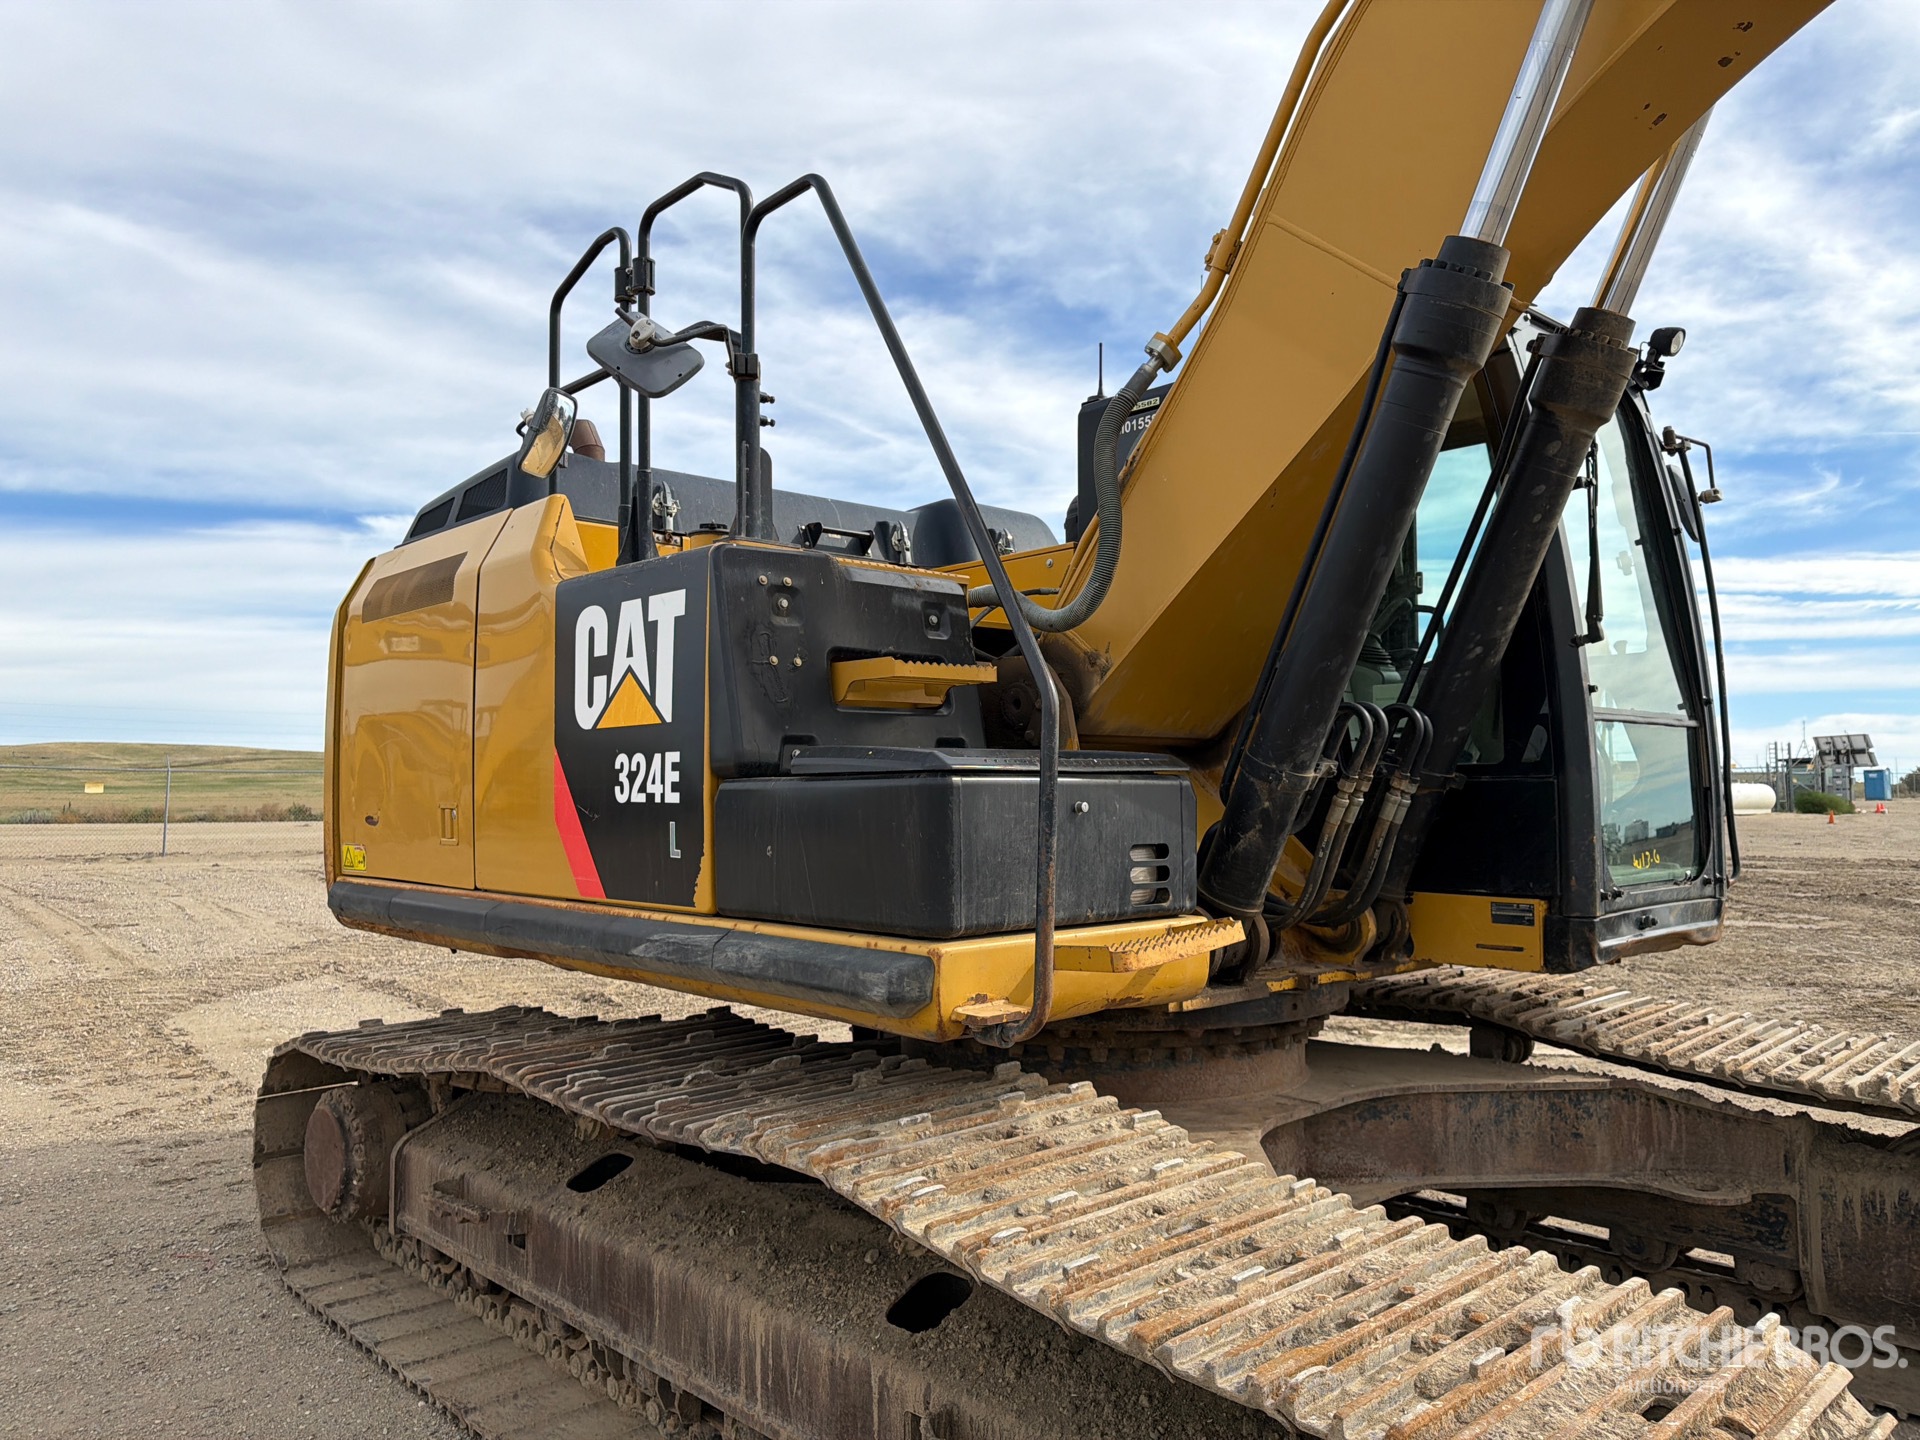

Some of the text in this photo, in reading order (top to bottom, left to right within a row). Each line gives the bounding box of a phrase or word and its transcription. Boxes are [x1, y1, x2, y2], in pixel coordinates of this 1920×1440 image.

[574, 588, 686, 730] CAT
[614, 751, 681, 804] 324E
[669, 821, 682, 859] L
